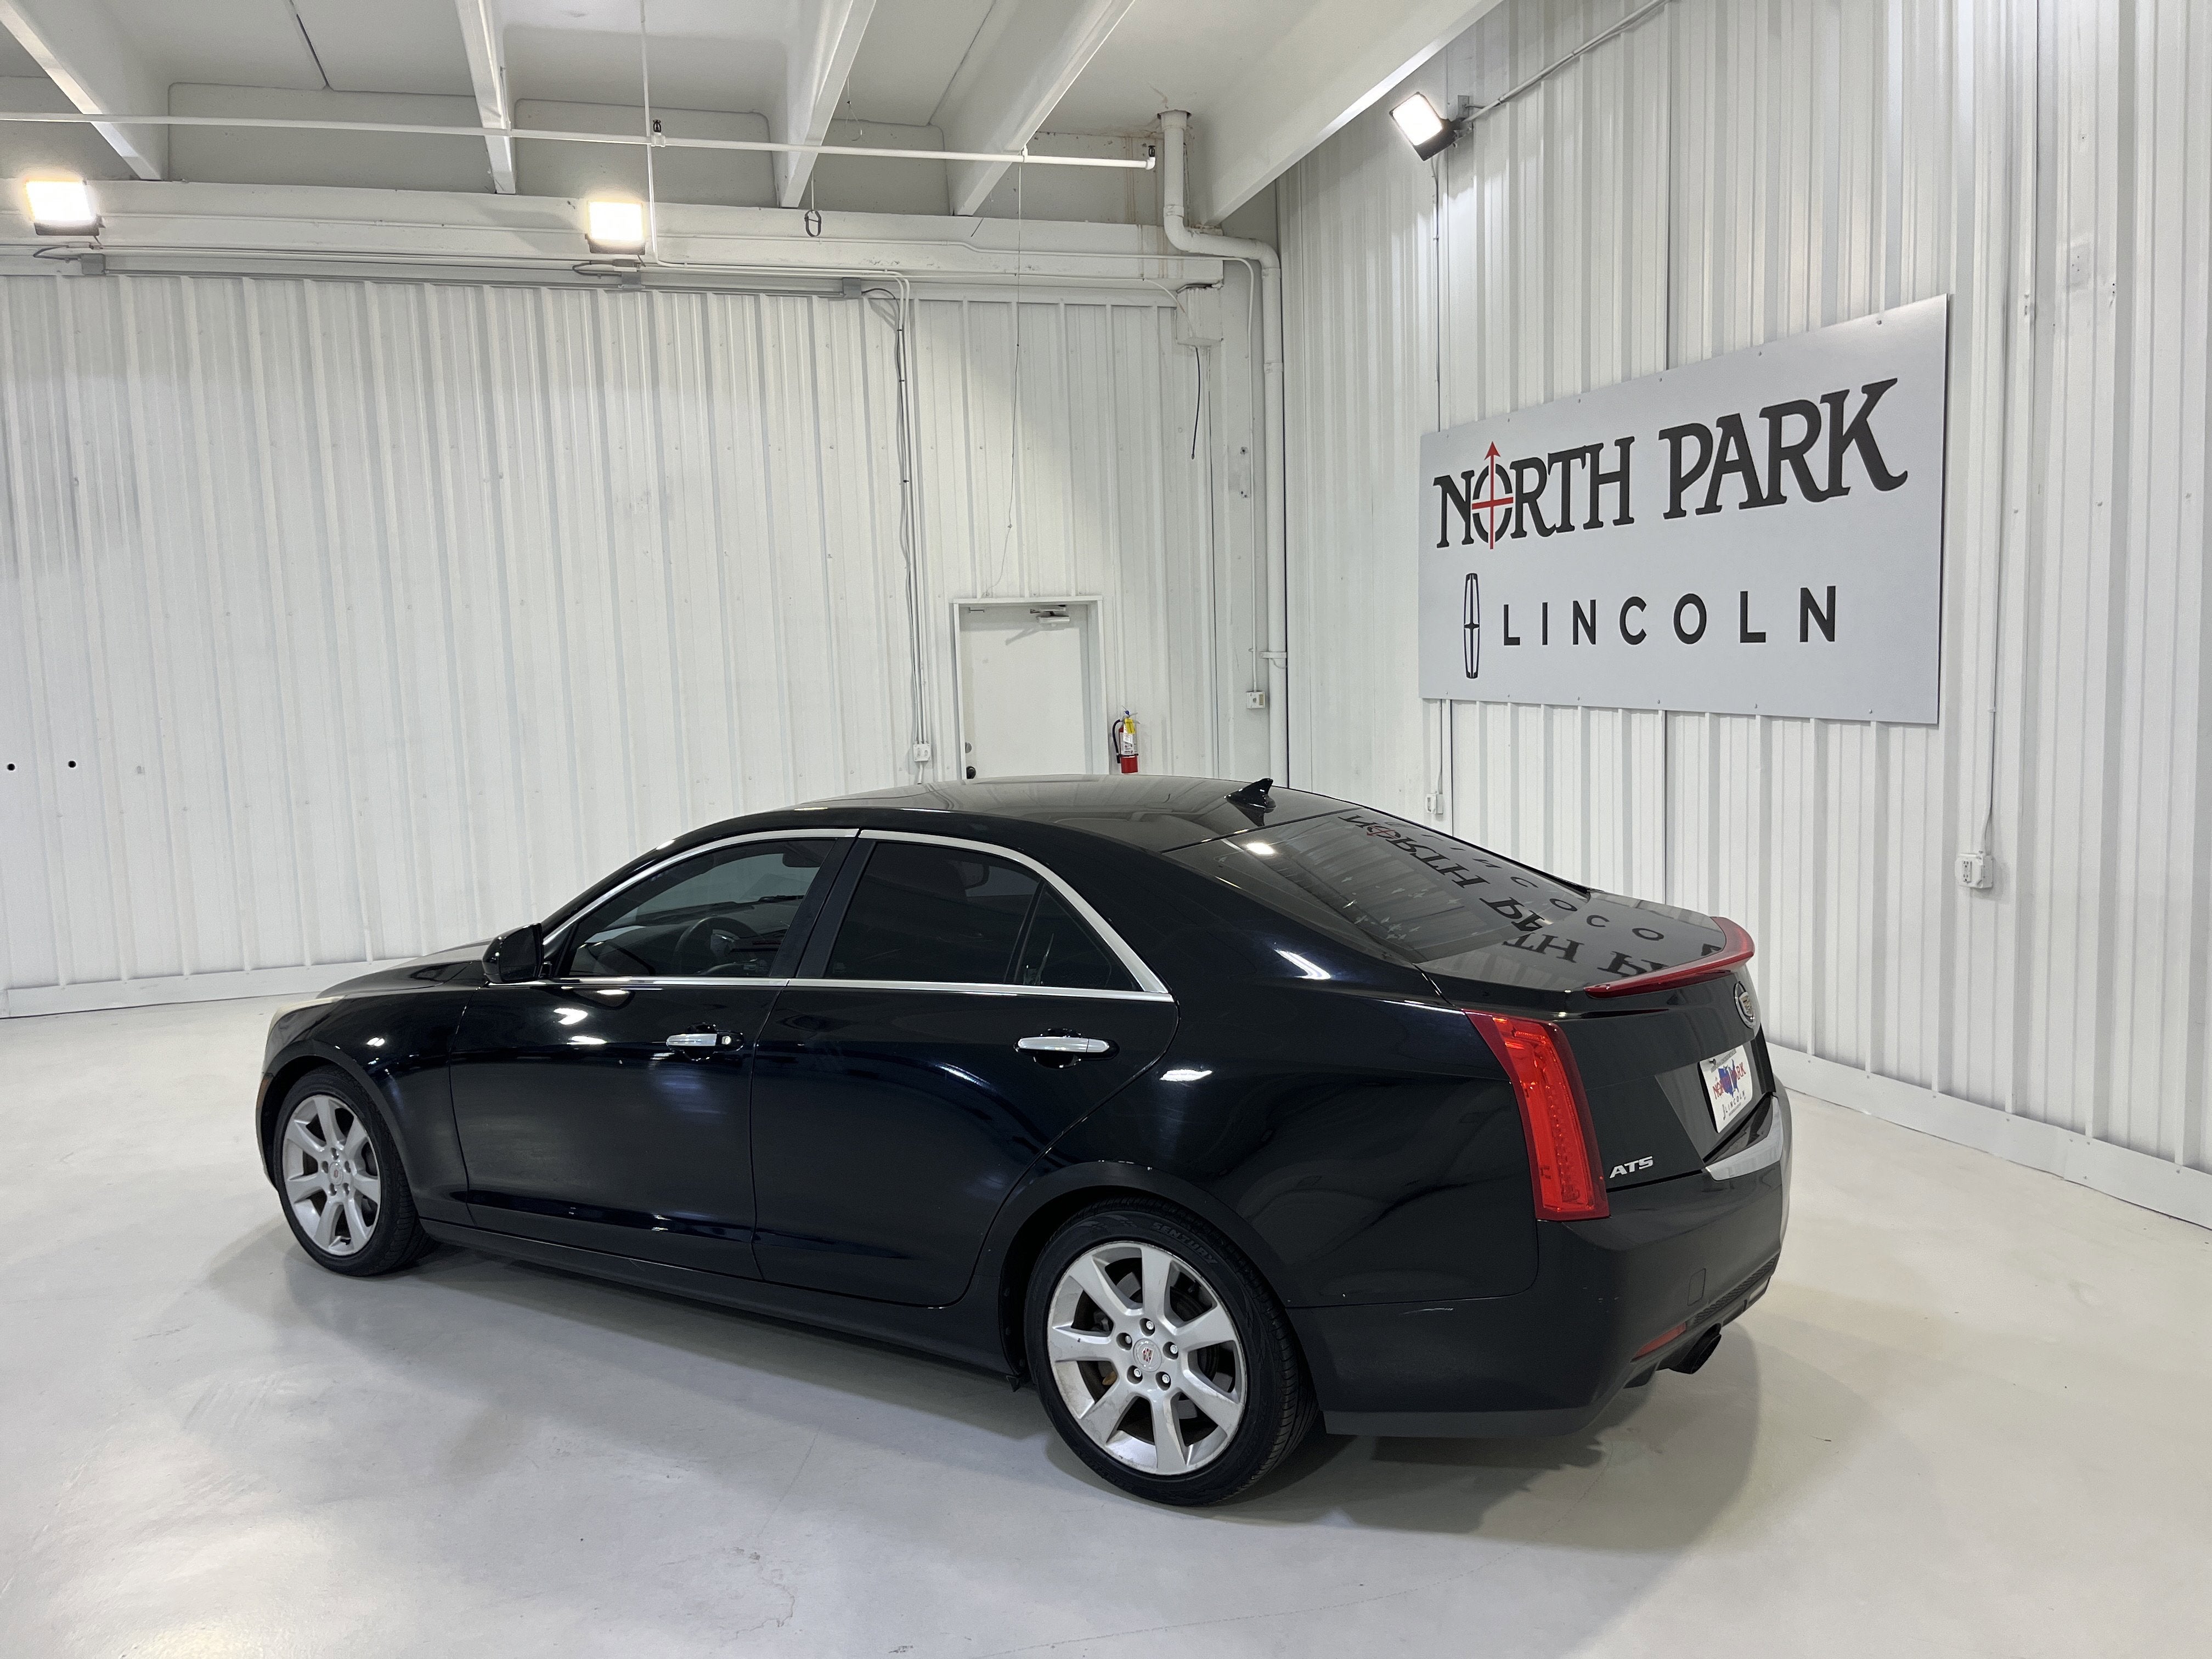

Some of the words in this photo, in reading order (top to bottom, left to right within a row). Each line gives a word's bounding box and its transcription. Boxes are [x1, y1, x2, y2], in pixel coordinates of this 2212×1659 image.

[1433, 436, 1635, 548] NORTH
[1658, 377, 1909, 520] PARK
[1503, 585, 1836, 646] LINCOLN
[1609, 1155, 1654, 1179] ATS
